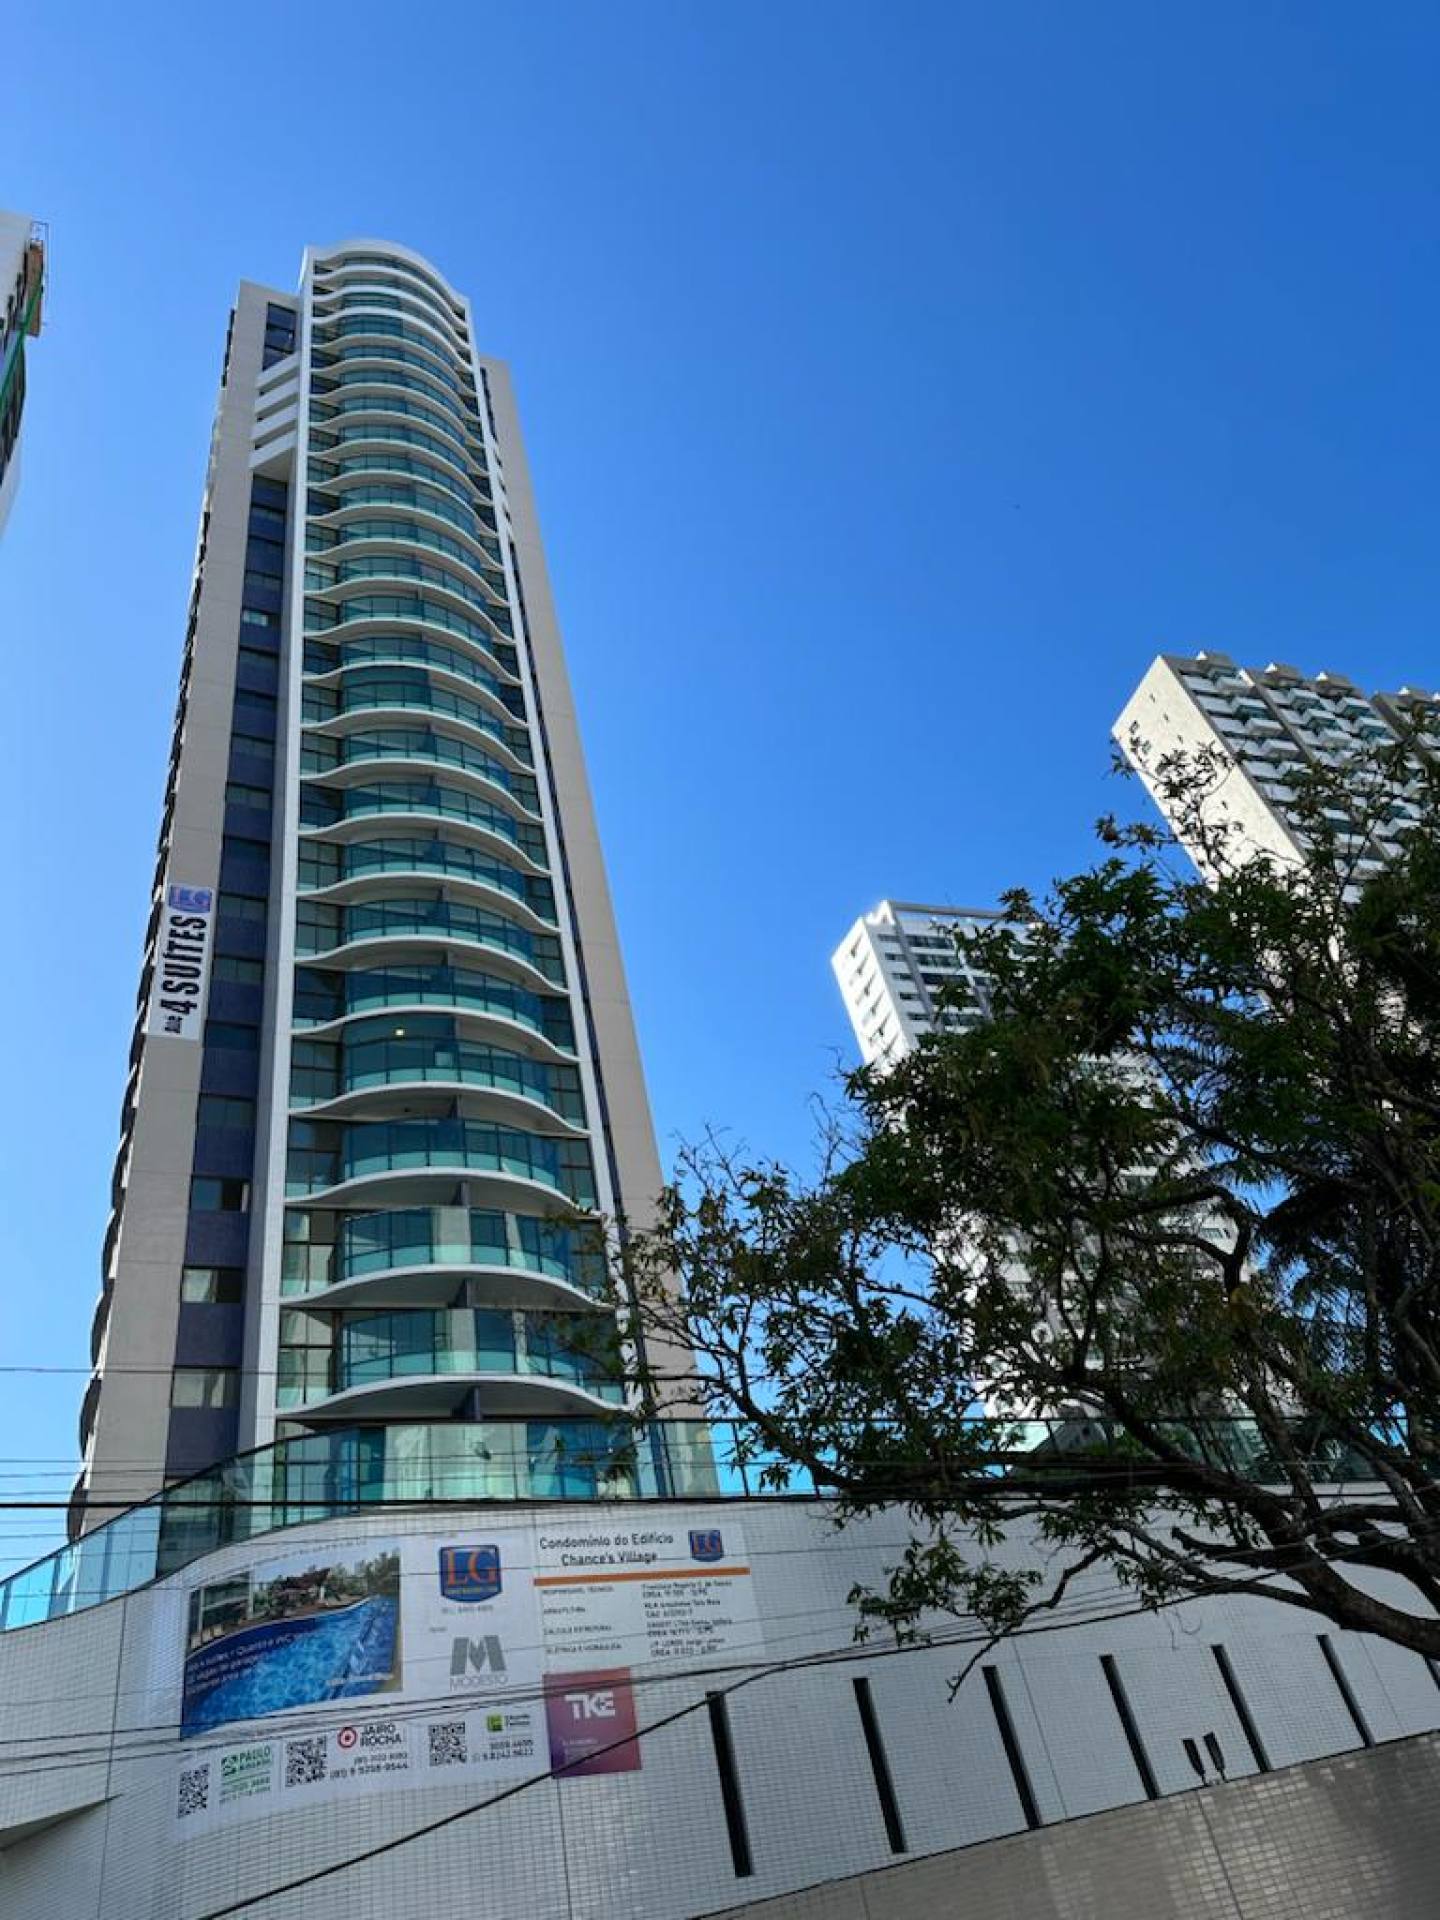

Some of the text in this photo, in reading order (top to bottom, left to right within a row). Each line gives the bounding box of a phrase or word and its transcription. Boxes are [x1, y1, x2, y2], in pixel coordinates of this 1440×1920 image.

[162, 915, 207, 994] SUÍTES
[160, 999, 197, 1015] 4
[539, 1534, 610, 1549] Condomínio
[614, 1534, 629, 1546] do
[446, 1549, 498, 1586] LG
[561, 1551, 658, 1567] Chance's Village
[565, 1690, 616, 1719] TKE
[361, 1732, 402, 1746] ROCHA
[240, 1745, 270, 1763] PAULO
